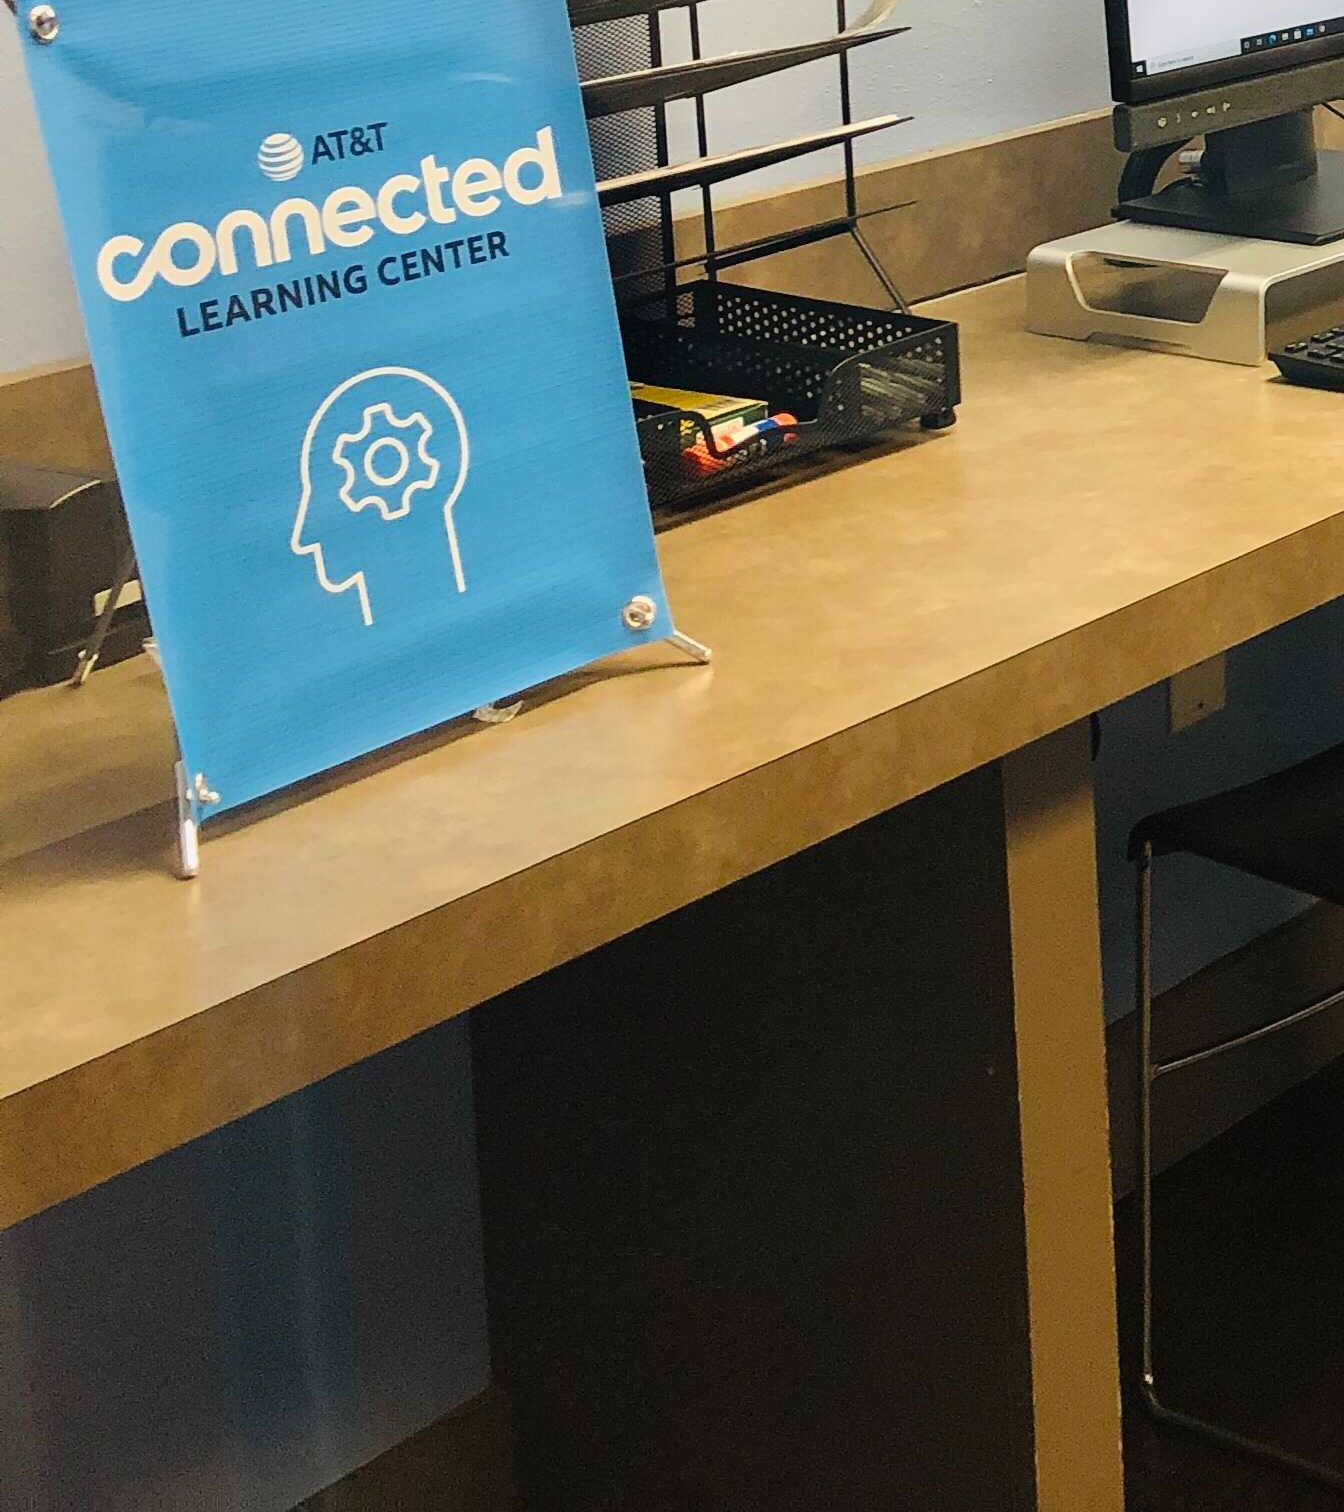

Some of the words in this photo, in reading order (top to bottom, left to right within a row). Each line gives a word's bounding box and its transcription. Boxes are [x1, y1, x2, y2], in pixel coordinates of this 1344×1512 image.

[311, 122, 389, 166] AT&T
[96, 125, 565, 302] connected
[176, 263, 368, 338] LEARNING
[377, 230, 510, 286] CENTER
